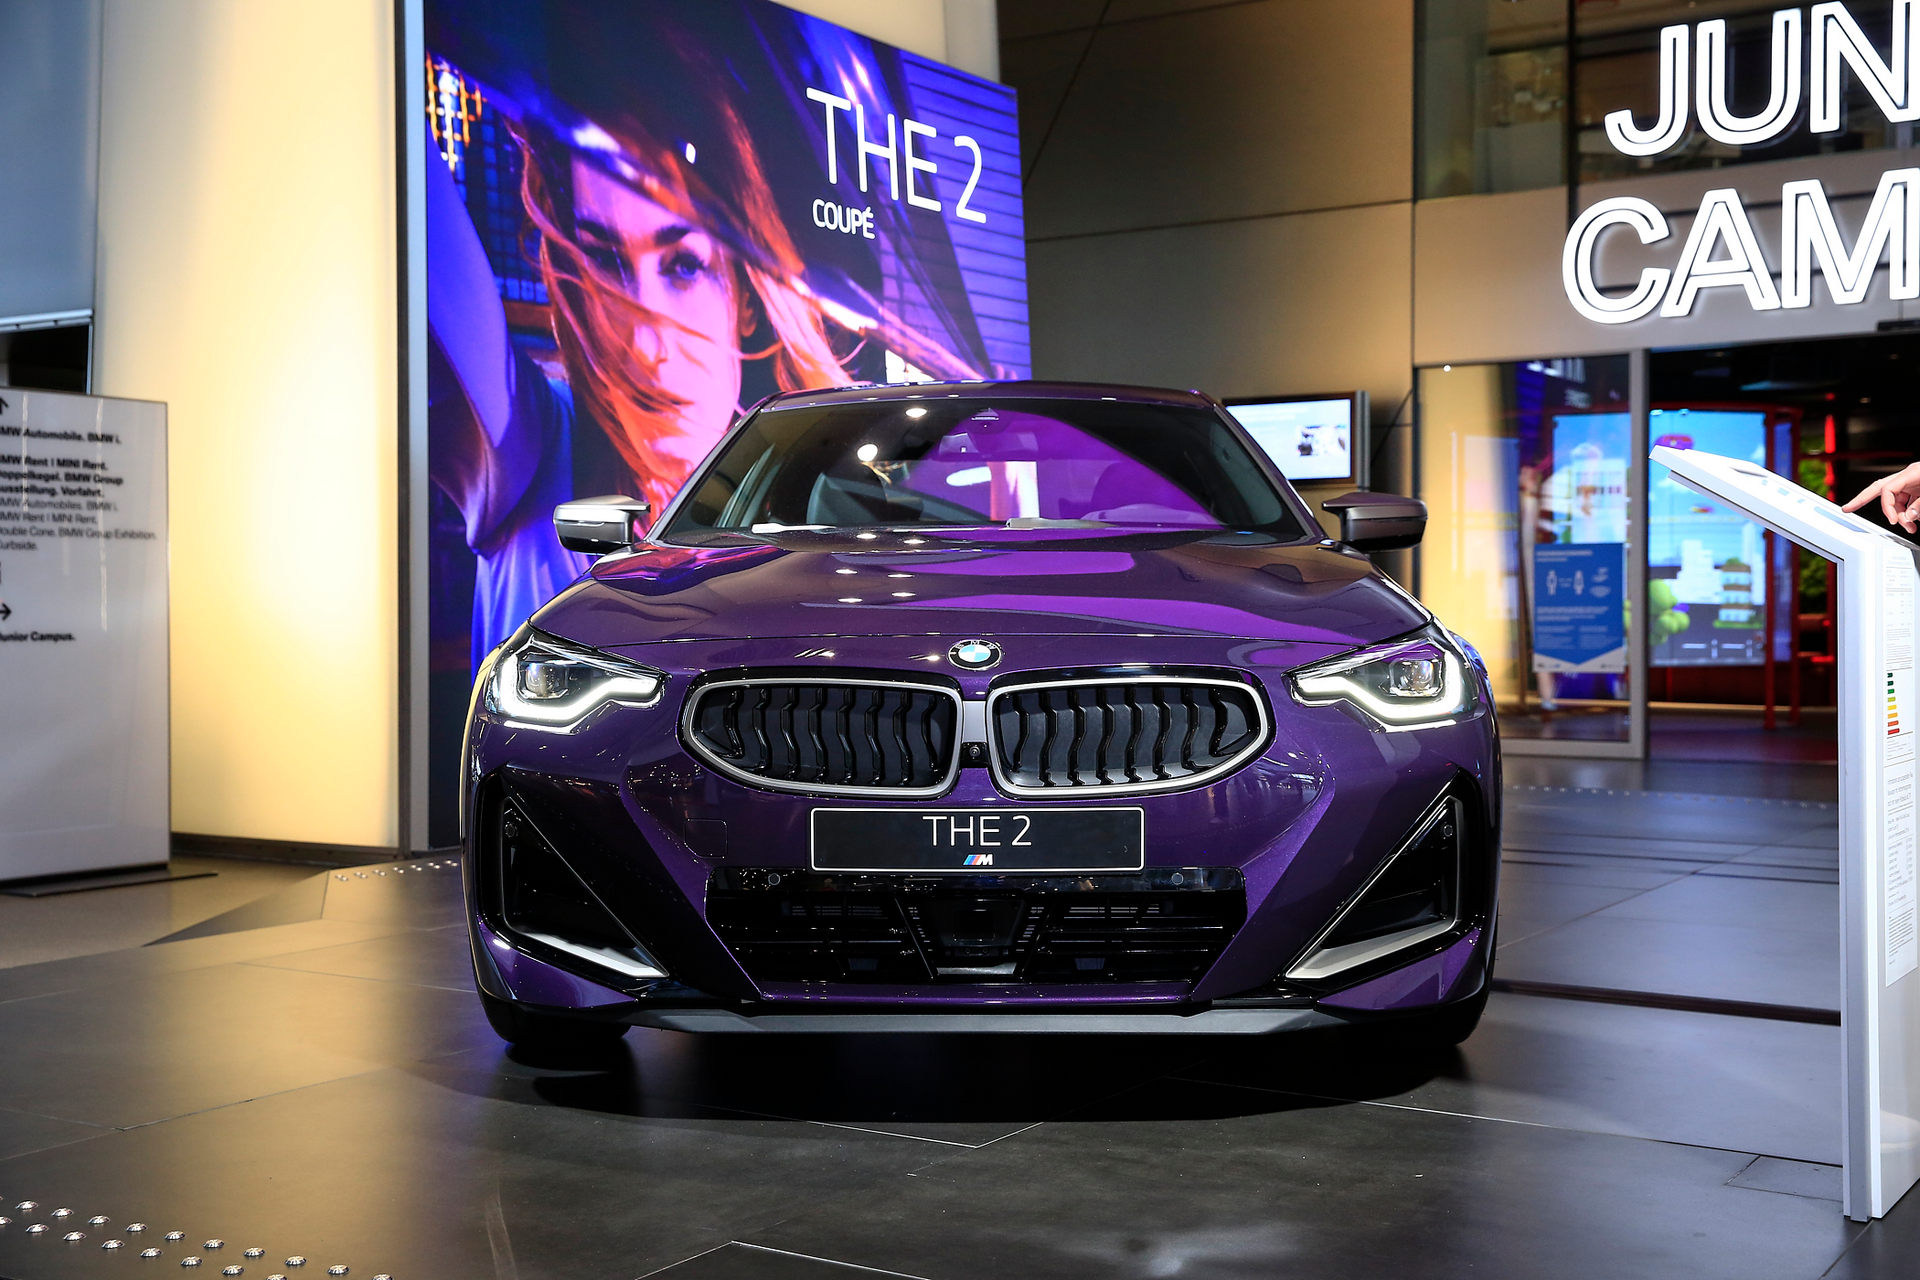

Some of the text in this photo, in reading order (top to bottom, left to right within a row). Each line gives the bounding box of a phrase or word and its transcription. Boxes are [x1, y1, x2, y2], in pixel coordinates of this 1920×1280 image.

[1604, 0, 1920, 156] JUN
[806, 87, 987, 224] THE 2
[812, 199, 876, 240] COUPÉ
[1562, 167, 1920, 324] CAM
[0, 426, 21, 437] MW
[23, 428, 85, 442] Automobile.
[87, 432, 114, 443] BMW
[0, 455, 22, 466] MW
[24, 455, 48, 468] Rent
[56, 458, 80, 469] MINI
[82, 459, 108, 471] Rent.
[0, 470, 123, 486] oppelkegel. BMW Group
[0, 485, 59, 498] usstellung.
[0, 497, 20, 507] MW
[86, 501, 111, 512] BMW
[0, 512, 20, 521] MW
[23, 512, 46, 523] Rent
[52, 513, 73, 523] MINI
[0, 527, 27, 537] ouble
[29, 526, 57, 538] Cone.
[58, 527, 84, 538] BMW
[86, 528, 113, 541] Group
[0, 541, 38, 551] urbside.
[30, 631, 76, 644] Campus.
[922, 815, 1032, 847] THE 2
